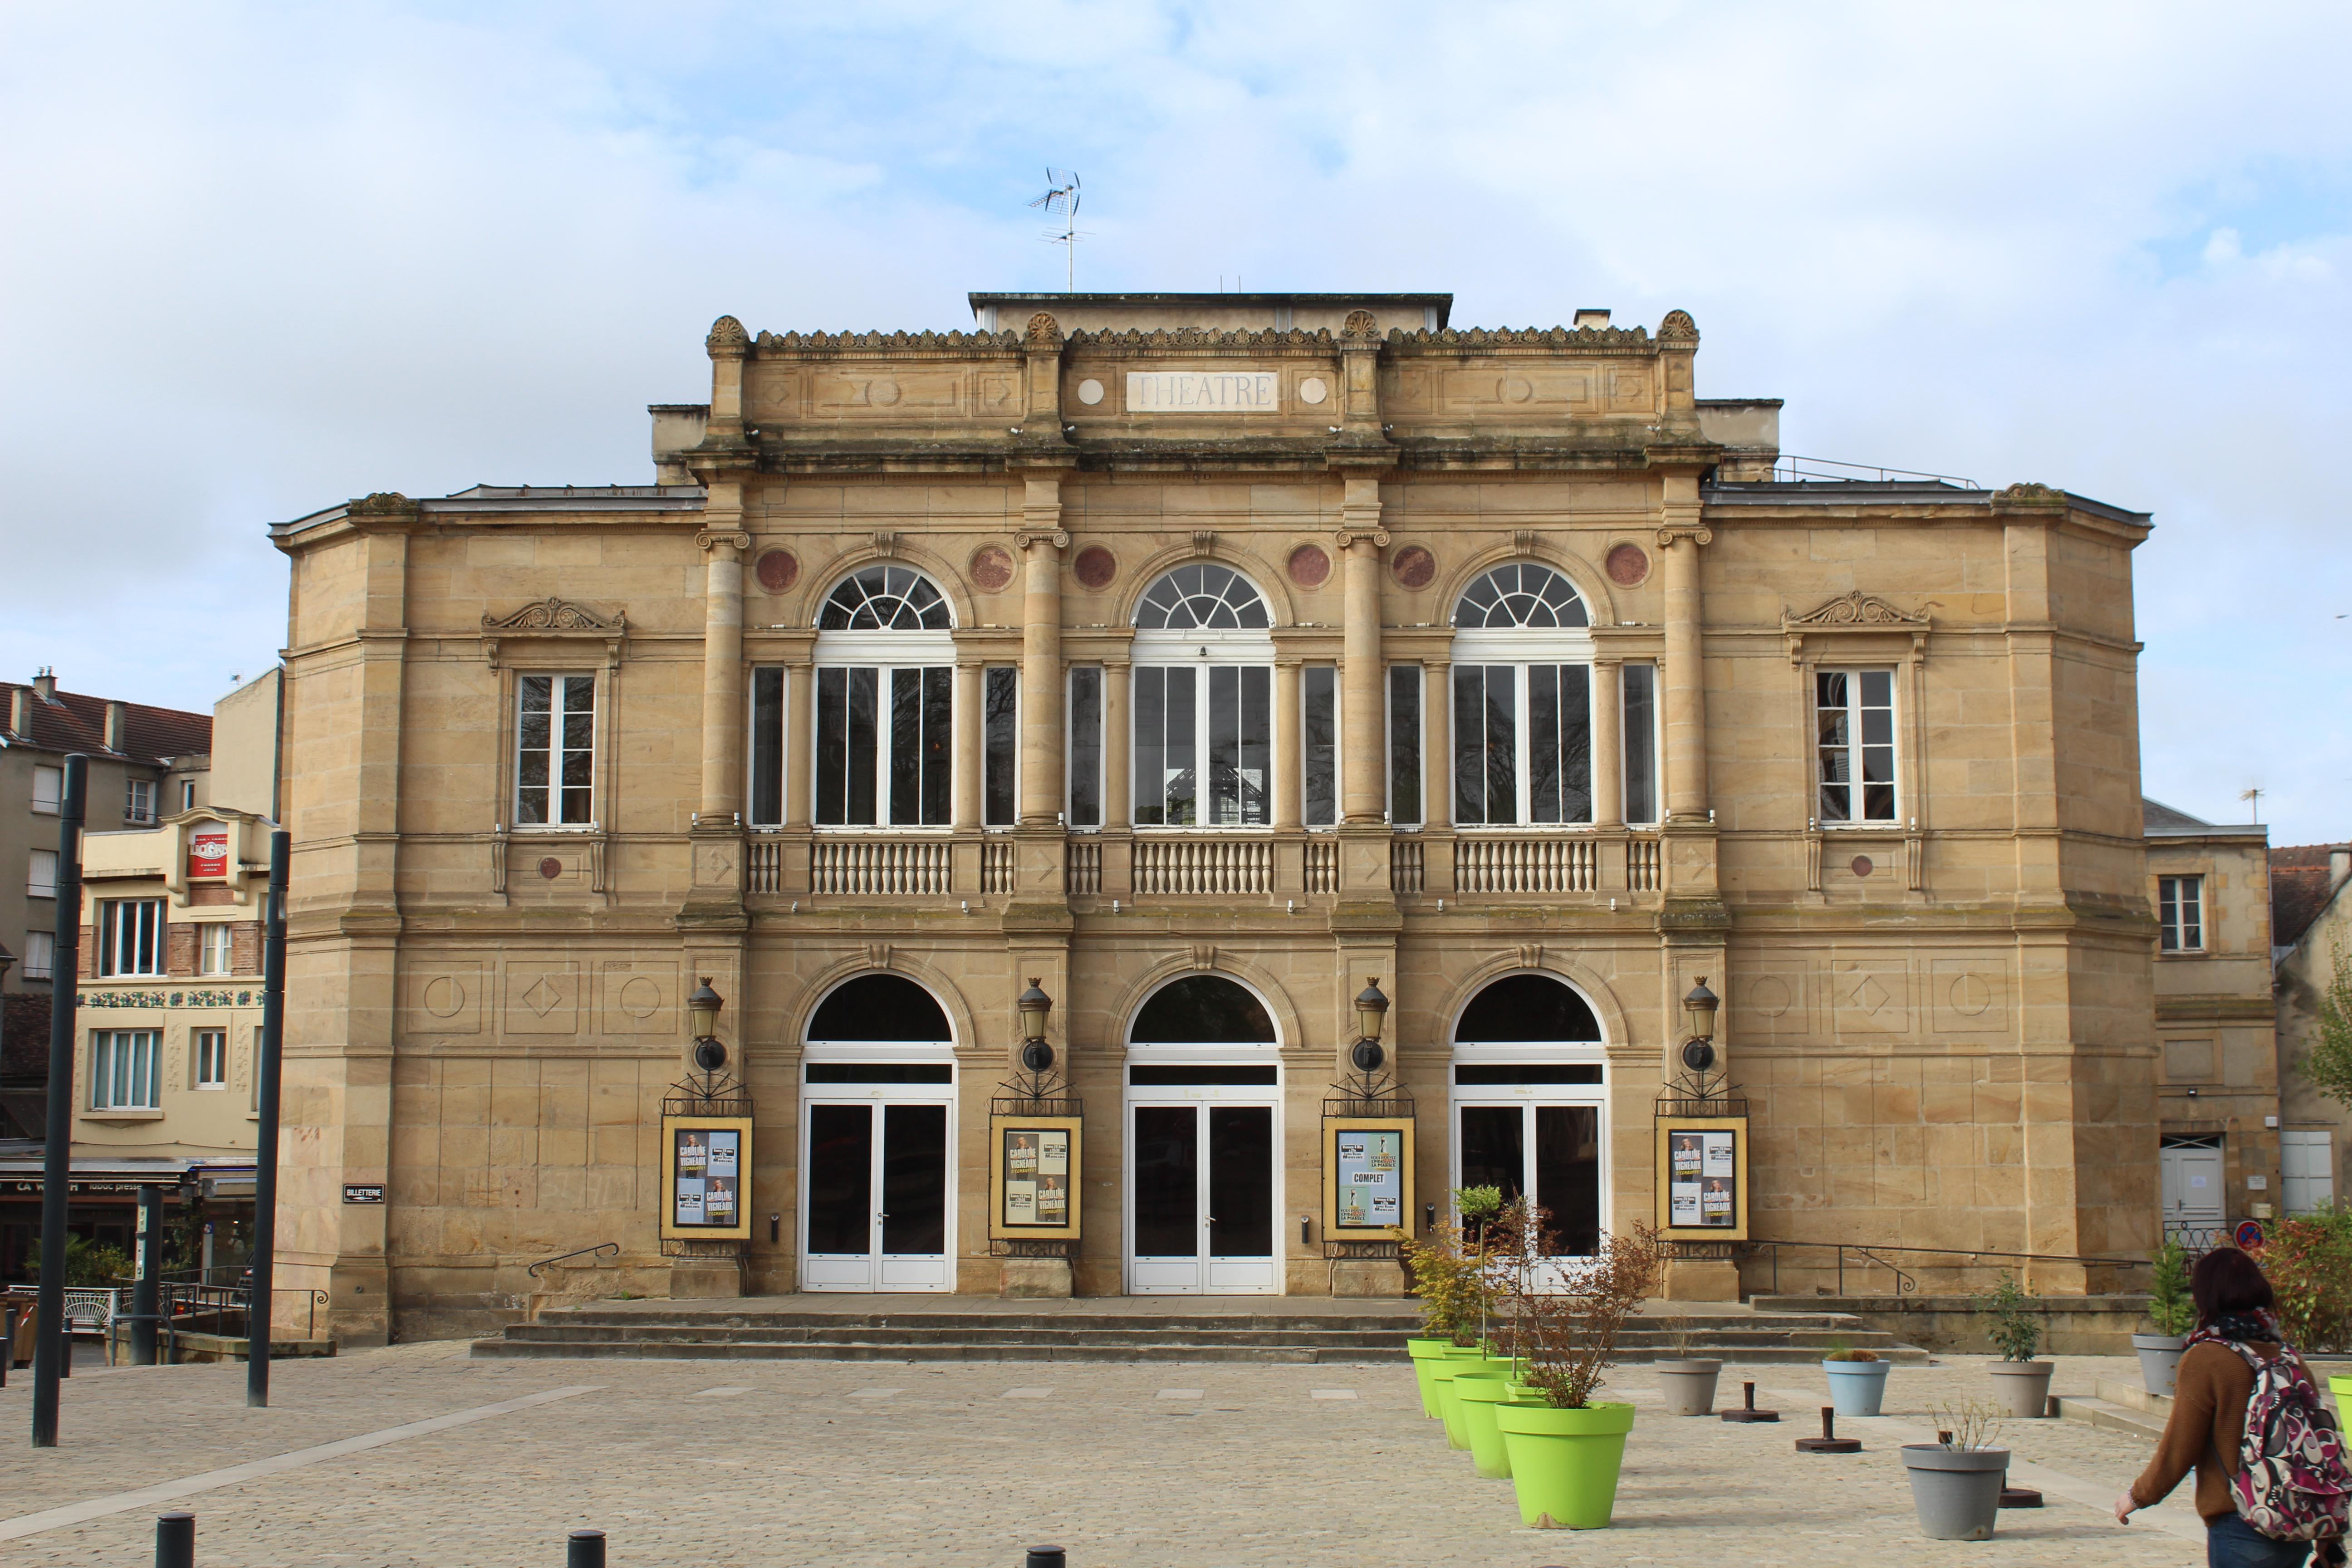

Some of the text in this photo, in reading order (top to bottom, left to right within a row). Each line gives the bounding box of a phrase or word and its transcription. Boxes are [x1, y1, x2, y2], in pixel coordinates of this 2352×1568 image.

[1136, 376, 1272, 405] THEATRE
[190, 841, 227, 856] LICORN
[680, 1146, 706, 1156] CAROLINE
[1010, 1148, 1036, 1158] CAROLINE
[1674, 1150, 1700, 1160] CAROLINE
[681, 1156, 706, 1166] VIGNEAUX
[1010, 1159, 1036, 1169] VIGNEAUX
[1675, 1160, 1701, 1171] VIGNEAUX
[1354, 1174, 1384, 1182] COMPLET
[707, 1191, 733, 1201] CAROLINE
[1039, 1189, 1064, 1199] CAROLINE
[1704, 1191, 1730, 1202] CAROLINE
[707, 1202, 733, 1211] VIGNEAUX
[1039, 1200, 1065, 1210] VIGNEAUX
[1704, 1202, 1730, 1212] VIGNEAUX
